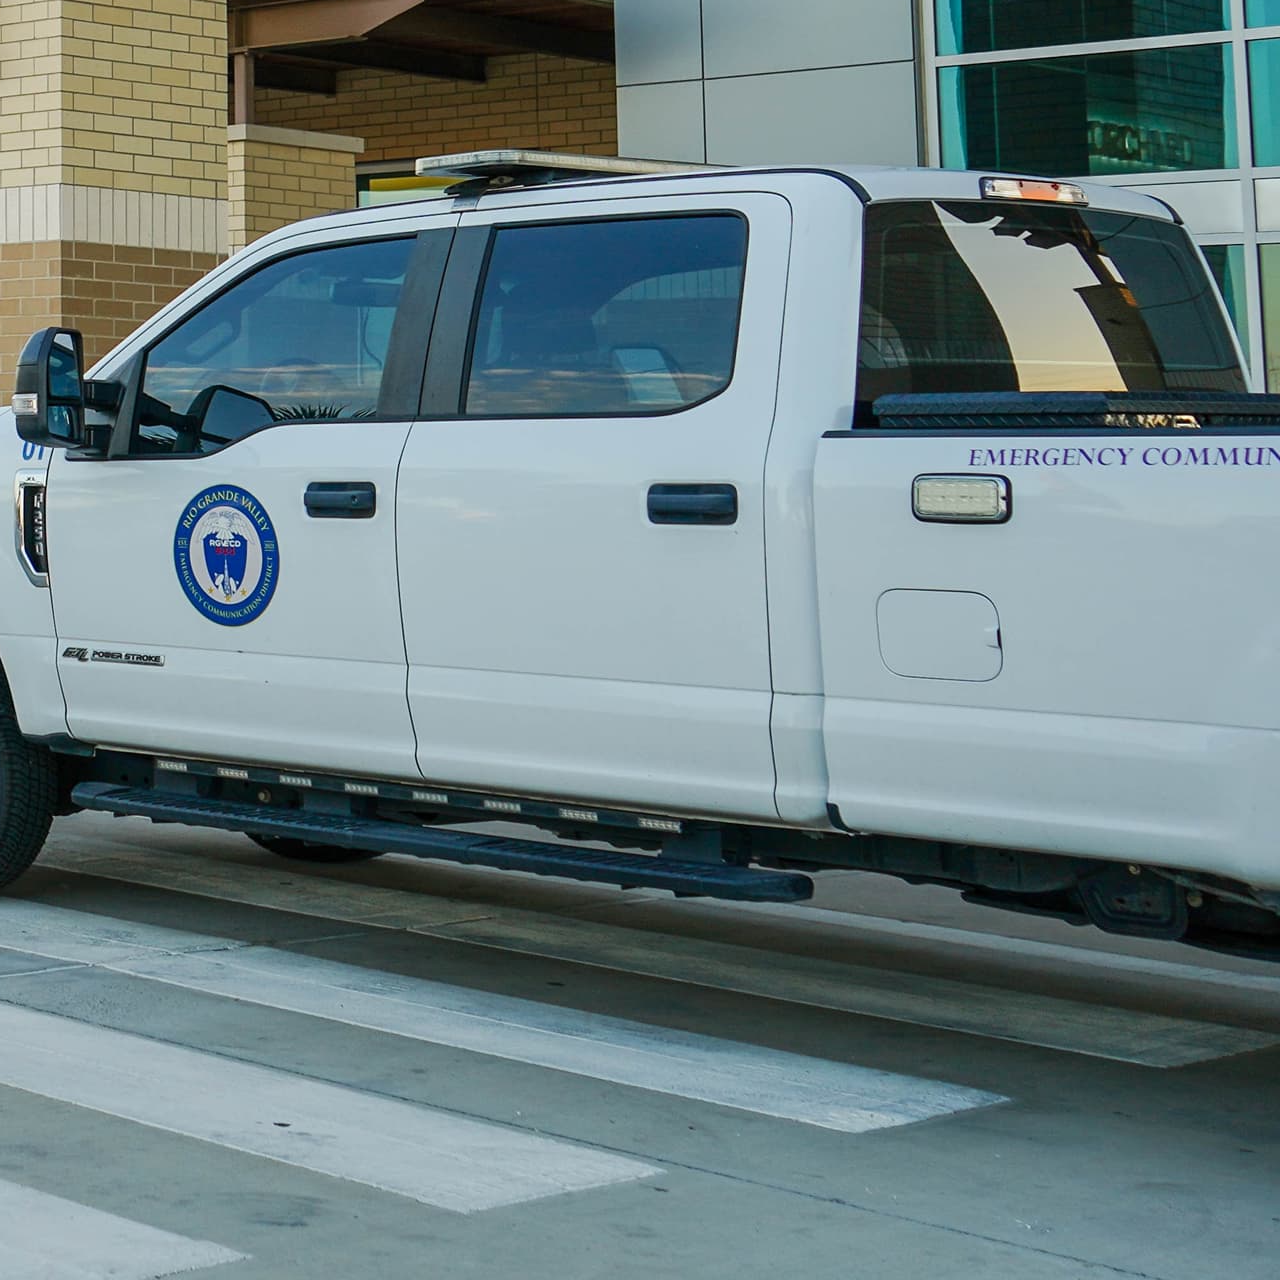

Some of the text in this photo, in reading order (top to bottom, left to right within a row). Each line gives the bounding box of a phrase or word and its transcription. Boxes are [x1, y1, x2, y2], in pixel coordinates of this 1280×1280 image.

[968, 446, 1134, 467] EMERGENCY
[182, 490, 270, 532] RIO GRANDE VALLEY
[179, 552, 274, 618] EMERGENCY COMMUNICATION DISTRICT
[92, 651, 162, 663] POWER STROKE
